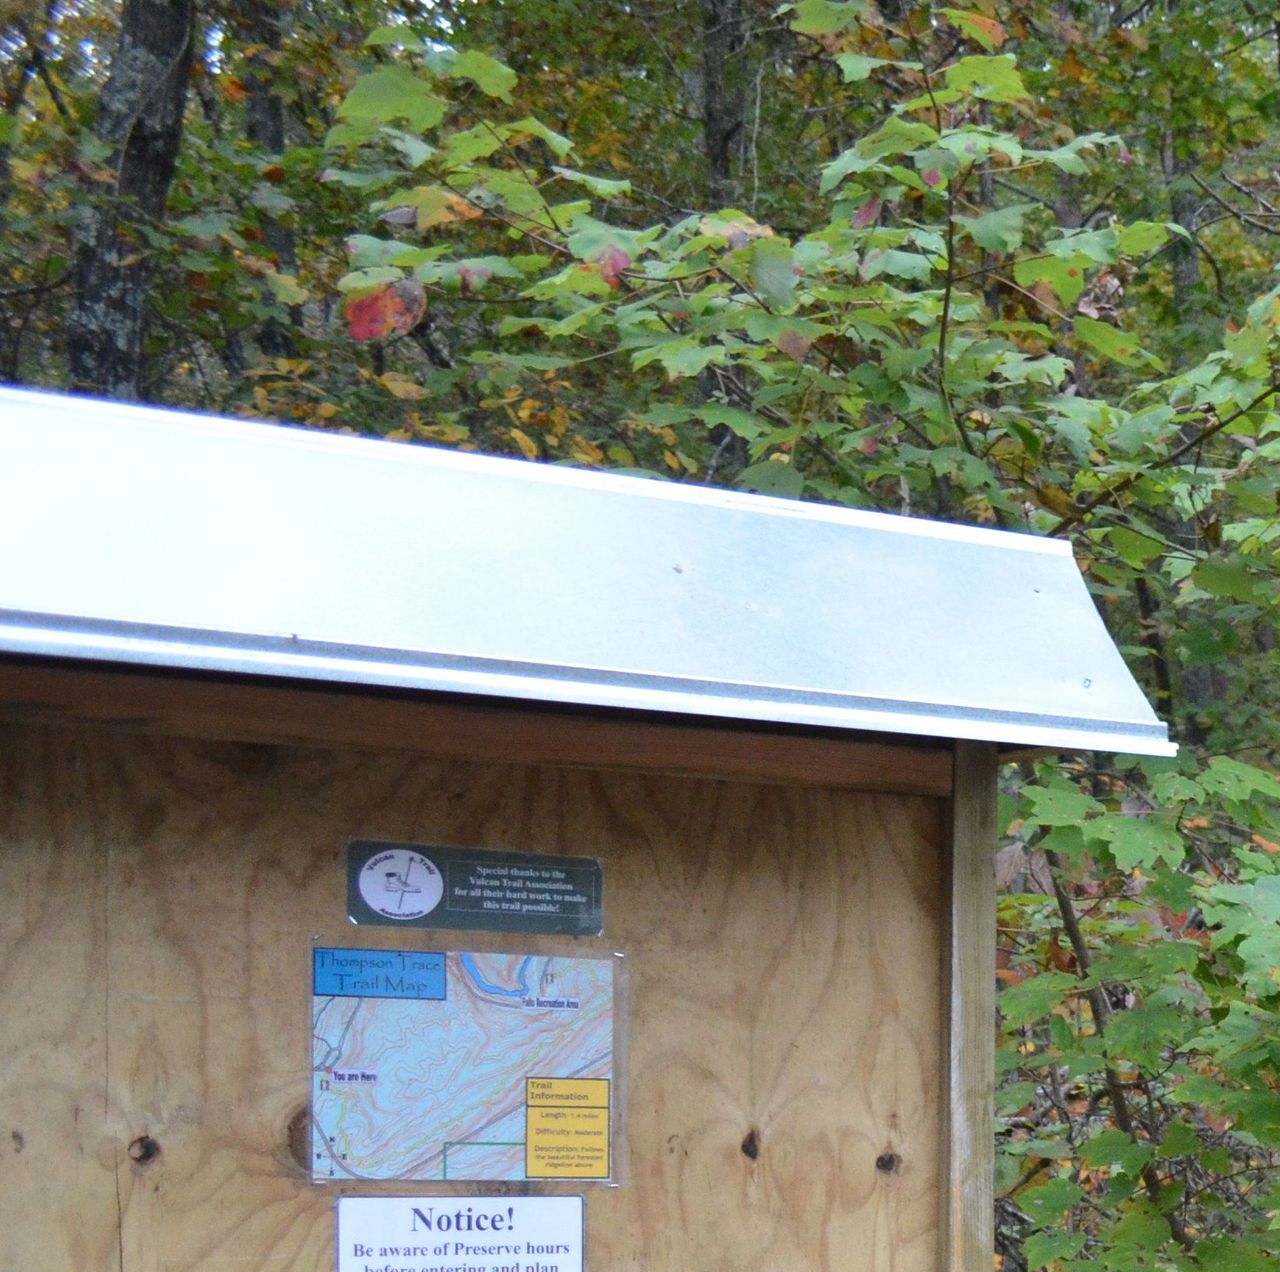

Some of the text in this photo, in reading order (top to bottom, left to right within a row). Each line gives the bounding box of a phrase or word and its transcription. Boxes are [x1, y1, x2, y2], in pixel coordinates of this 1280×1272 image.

[366, 854, 436, 875] Vulcan Trail
[476, 865, 508, 876] Special
[510, 867, 539, 877] thanks
[552, 870, 566, 878] the
[470, 876, 573, 890] Vulcan Trail Association
[455, 888, 468, 896] for
[483, 889, 504, 898] their
[506, 890, 527, 899] hard
[529, 892, 551, 900] work
[564, 894, 587, 903] make
[379, 908, 423, 918] Association
[483, 900, 559, 913] this trail possible!
[319, 951, 440, 974] Thompson Trace
[332, 973, 428, 994] Trail Map
[334, 1071, 377, 1081] You are Here
[530, 1081, 553, 1089] Trail
[530, 1092, 589, 1100] Information
[535, 1128, 572, 1136] Difficulty:
[534, 1145, 578, 1154] Description:
[410, 1206, 515, 1232] Notice!
[353, 1241, 570, 1257] Be aware of Preserve hours
